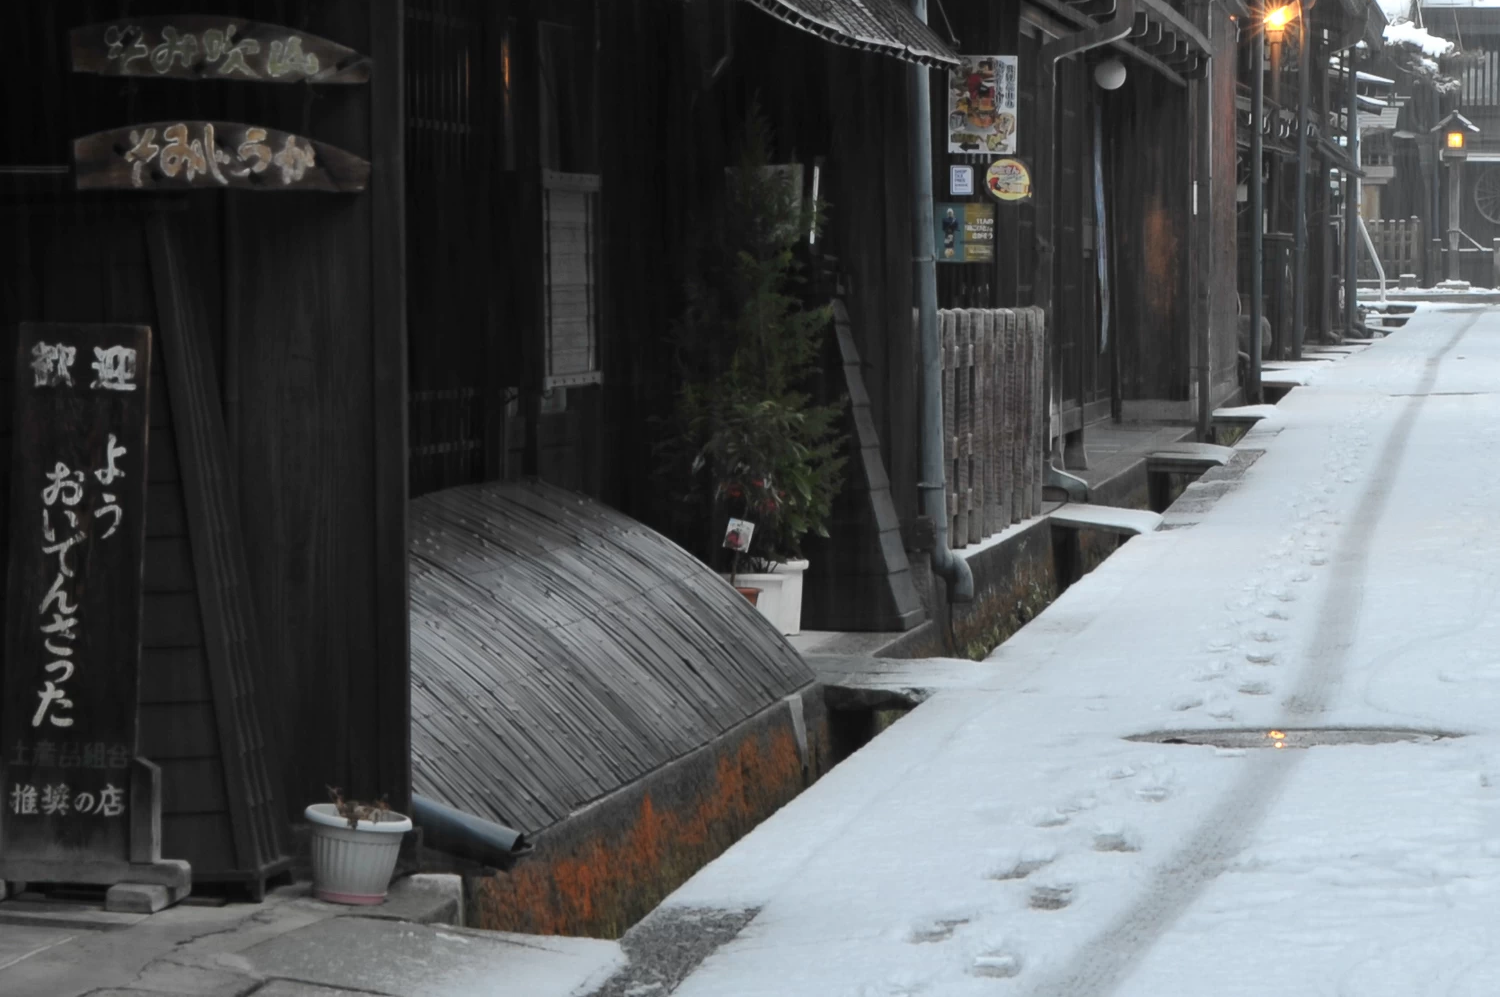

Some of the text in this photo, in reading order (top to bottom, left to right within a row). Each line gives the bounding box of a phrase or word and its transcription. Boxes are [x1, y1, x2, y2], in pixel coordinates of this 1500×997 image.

[31, 342, 137, 391] 歓迎
[95, 434, 127, 539] よう
[32, 462, 85, 727] おいでんさった
[9, 782, 125, 817] 推奨の店
